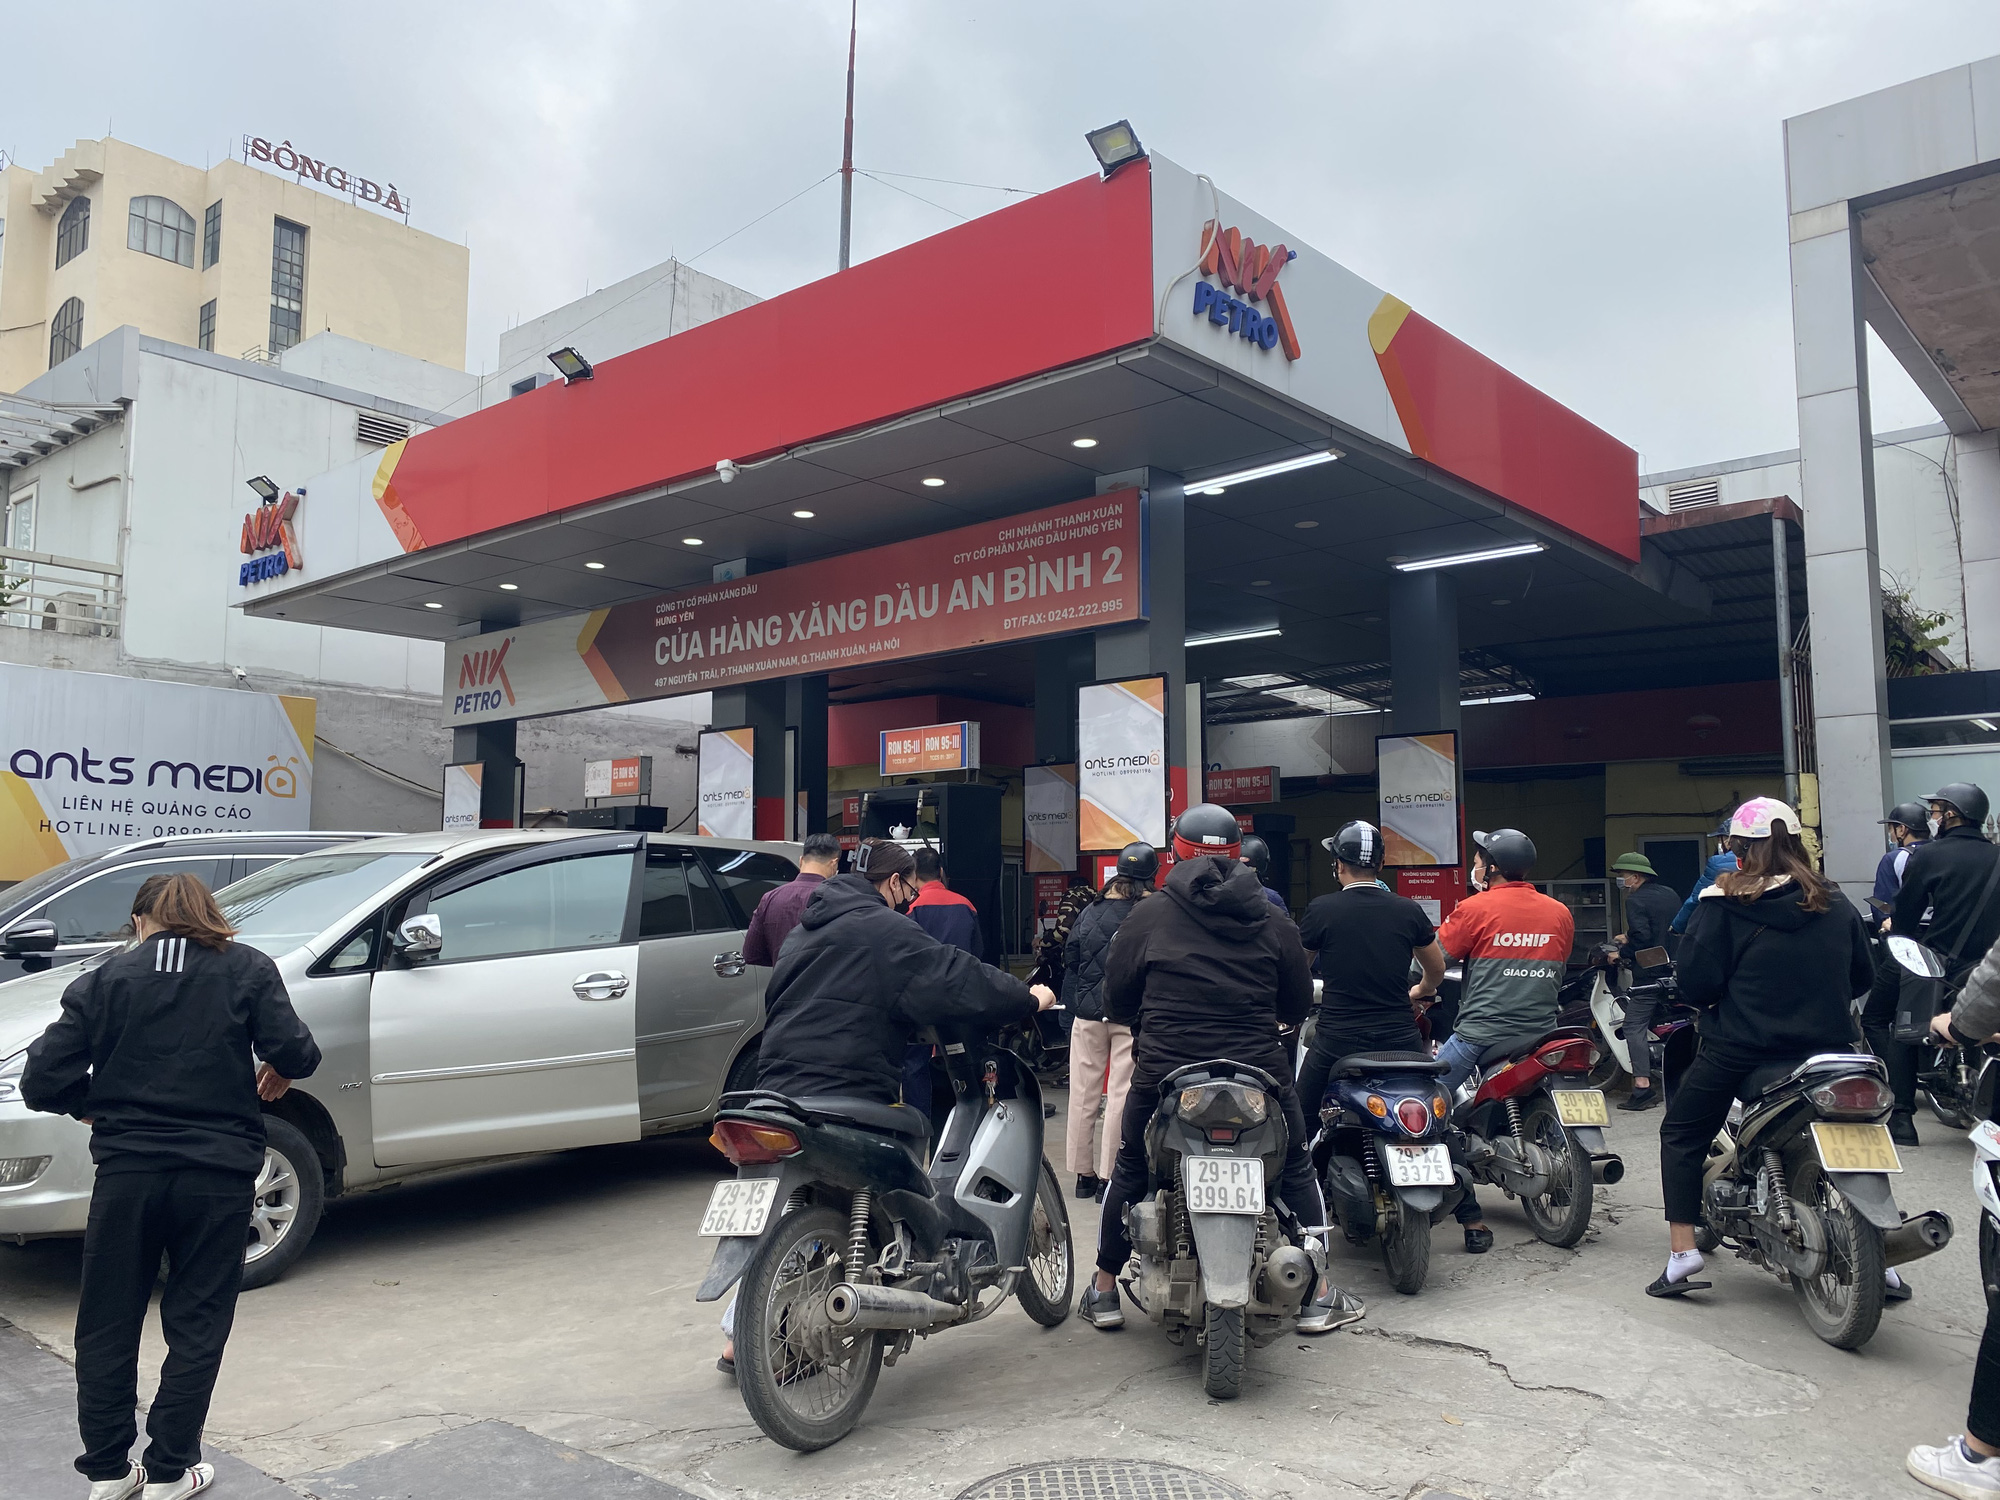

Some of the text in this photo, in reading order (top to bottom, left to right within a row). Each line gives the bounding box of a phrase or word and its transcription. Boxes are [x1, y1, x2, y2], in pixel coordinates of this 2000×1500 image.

[251, 137, 405, 214] SÔNG ĐÀ
[1199, 219, 1301, 361] NIK
[1193, 280, 1279, 350] PETRO
[998, 503, 1123, 541] CHI NHÁNH THANH XUÂN
[954, 552, 972, 565] CTY
[988, 540, 1015, 558] PHẦN
[1016, 534, 1044, 551] XĂNG
[1046, 528, 1067, 545] DẦU
[1069, 524, 1099, 540] HƯNG
[1101, 518, 1123, 533] YÊN
[239, 551, 289, 586] PETRO
[655, 546, 1123, 666] CỬA HÀNG XĂNG DẦU AN BÌNH 2
[656, 602, 676, 614] CÔNG
[676, 600, 686, 610] TY
[1048, 598, 1123, 623] 0242.222.995
[656, 611, 695, 627] HƯNG YÊN
[459, 638, 515, 706] NIK
[655, 678, 667, 687] 497
[668, 670, 698, 686] NGUYỄN
[755, 658, 777, 671] XUÂN
[779, 656, 800, 668] NAM,
[869, 640, 881, 653] HÀ
[884, 637, 900, 651] NỘI
[454, 690, 502, 715] PETRO
[888, 739, 920, 755] RON 95-III
[925, 734, 960, 751] RON 95-III
[10, 747, 135, 786] ants
[1085, 756, 1114, 769] ants
[1209, 779, 1223, 791] RON
[1237, 777, 1250, 788] RON
[62, 795, 251, 819] LIÊN HỆ QUẢNG CÁO
[1385, 793, 1411, 803] ants
[40, 820, 142, 837] HOTLINE:
[1492, 932, 1558, 947] LOSHIP
[1503, 968, 1528, 977] GIAO
[1826, 1127, 1881, 1146] 17-M8
[1831, 1148, 1890, 1167] 8576
[1199, 1161, 1250, 1184] 29-P1
[1399, 1165, 1445, 1182] 3375
[718, 1182, 768, 1206] 29-X5
[1193, 1185, 1259, 1209] 399.64
[704, 1208, 764, 1232] 564.13
